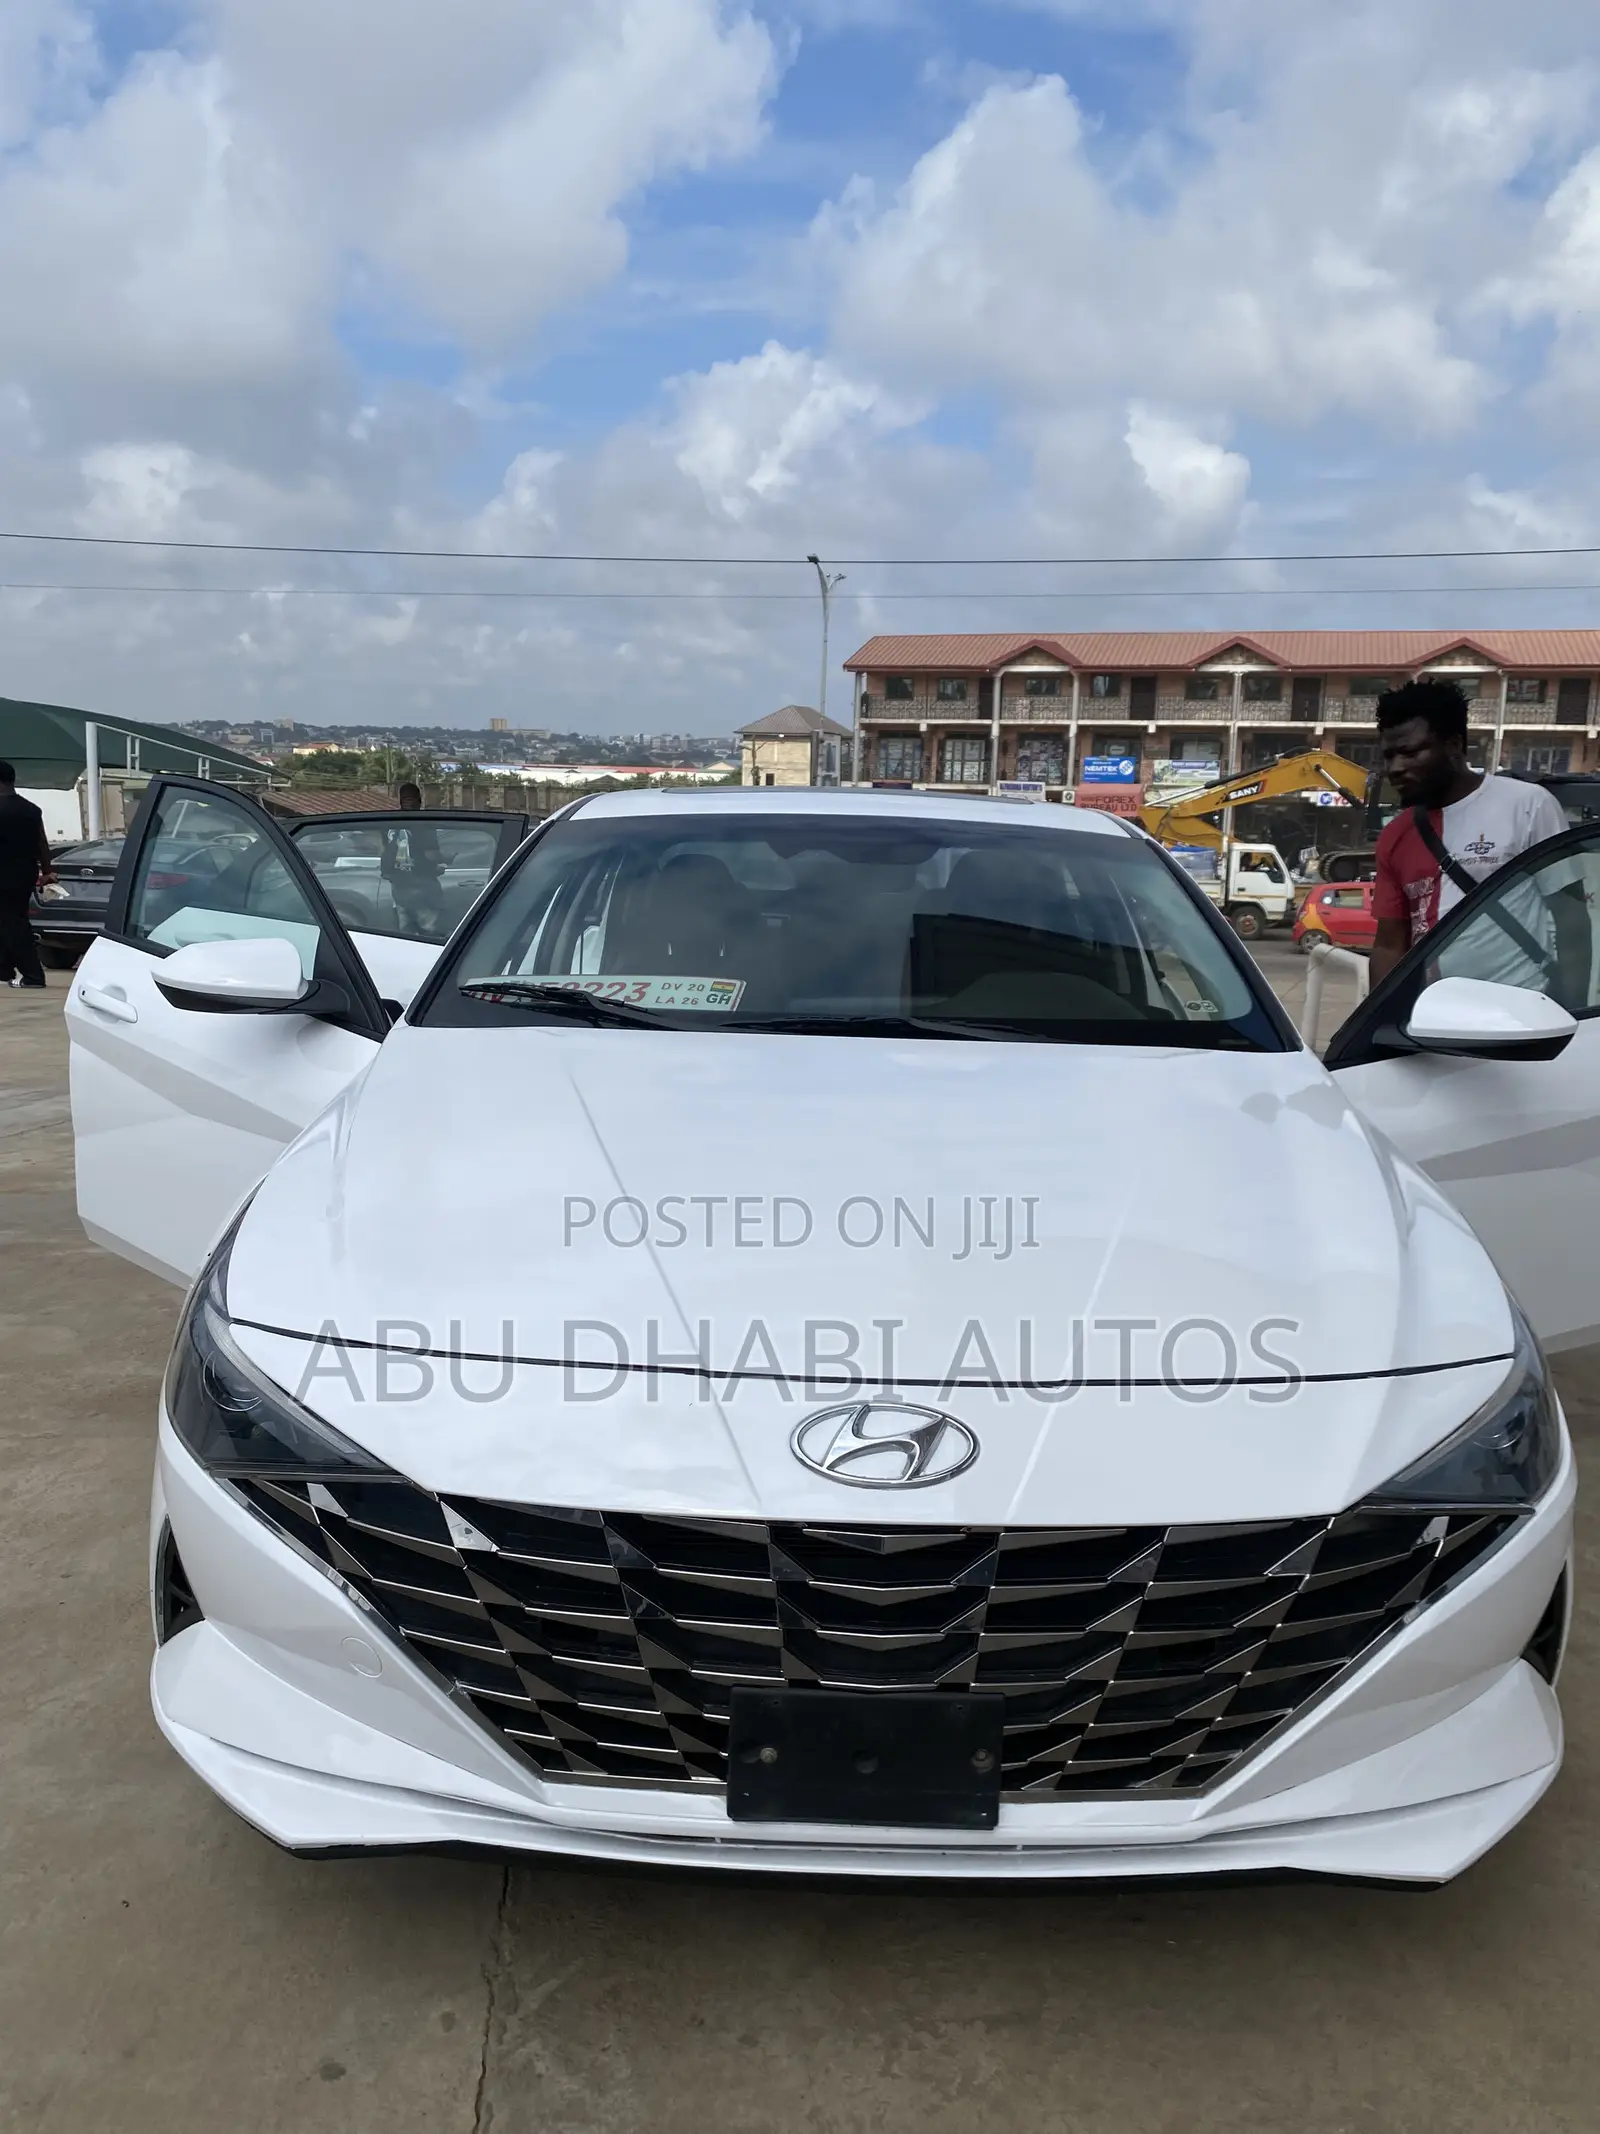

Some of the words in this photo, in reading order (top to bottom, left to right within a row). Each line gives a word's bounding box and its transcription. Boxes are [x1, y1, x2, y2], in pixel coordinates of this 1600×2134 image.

[1229, 785, 1259, 800] SANY
[1095, 795, 1136, 804] FOREX
[660, 982, 683, 991] DV
[687, 983, 706, 992] 20
[654, 996, 676, 1005] LA
[681, 996, 700, 1006] 26
[706, 992, 733, 1005] GH
